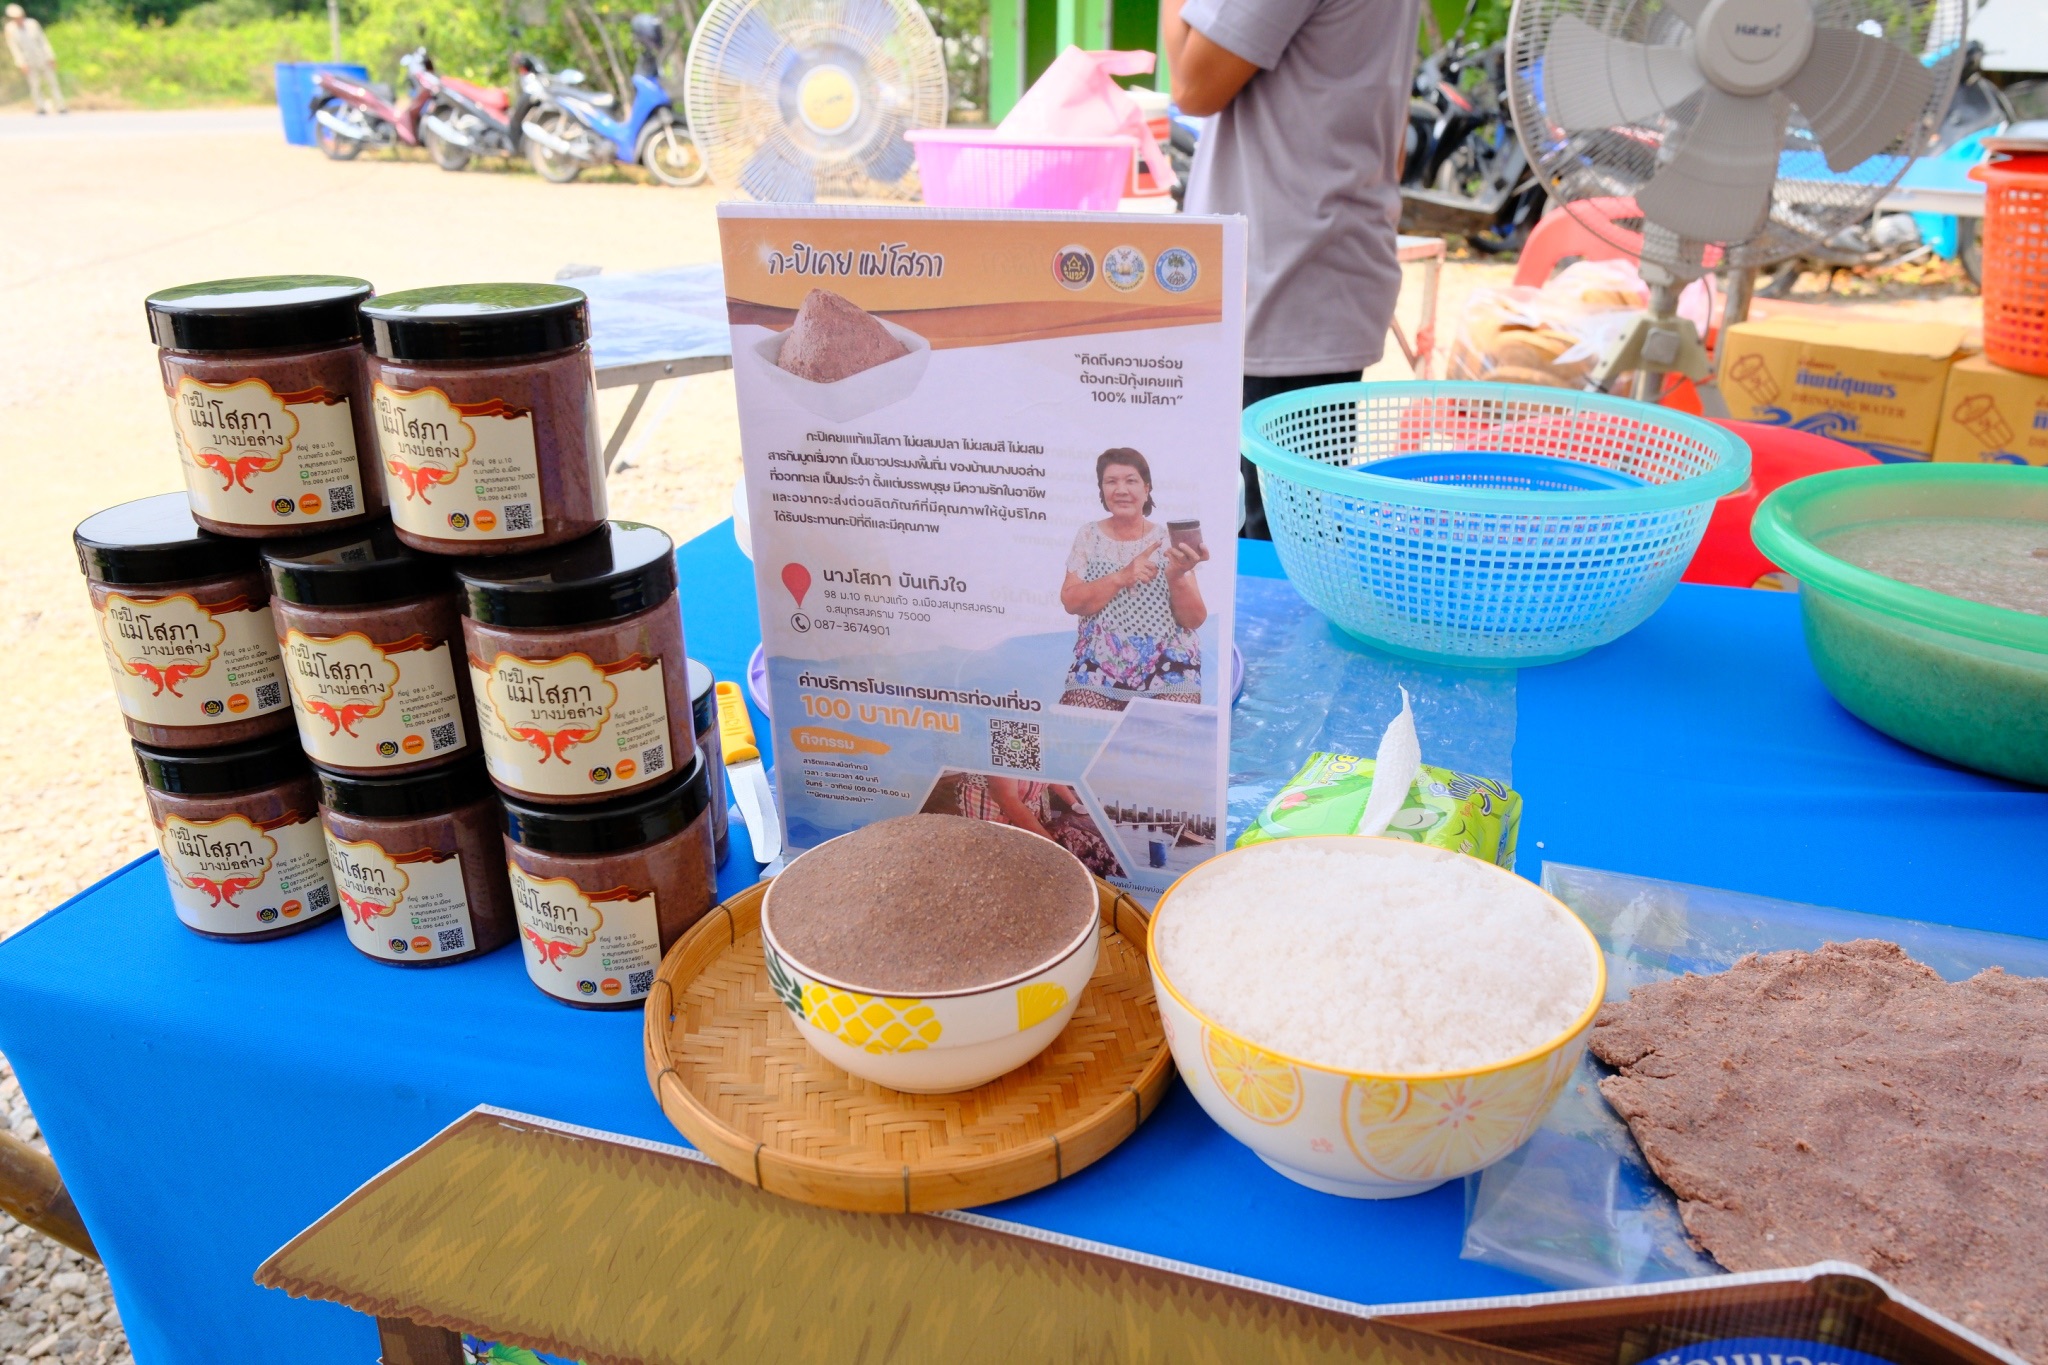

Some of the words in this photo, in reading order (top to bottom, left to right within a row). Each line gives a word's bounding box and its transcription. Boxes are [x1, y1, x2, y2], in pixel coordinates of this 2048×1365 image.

[769, 242, 852, 275] กะปิเคย
[859, 244, 943, 277] แม่โสภา
[1080, 370, 1183, 389] ต้องกะปิกุ้งเคยแท้
[182, 391, 204, 408] กะปิ
[377, 396, 391, 414] กะปิ
[1091, 391, 1126, 403] 100%
[190, 400, 271, 430] แม่โสภา
[382, 407, 448, 440] แม่โสภา
[213, 430, 284, 446] บางบ่อล่าง
[903, 435, 959, 450] ไม่ผสมปลา
[962, 438, 1005, 453] ไม่ผสมสี
[1008, 441, 1044, 455] ไม่ผสม
[398, 440, 459, 458] บางบ่อล่าง
[340, 455, 356, 463] 75000
[517, 473, 536, 481] 75000
[770, 467, 820, 483] ที่ออกทะเล
[823, 471, 870, 487] เป็นประจำ
[823, 568, 891, 587] นางโสภา
[899, 571, 967, 593] บันเทิงใจ
[824, 589, 837, 599] 98
[840, 591, 861, 602] ม.10
[864, 594, 908, 606] ต.บางแก้ว
[912, 598, 1005, 614] อ.เมืองสมุทรสงคราม
[111, 606, 132, 622] กะปิ
[825, 605, 894, 619] จ.สมุทรสงคราม
[898, 611, 931, 622] 75000
[118, 614, 199, 640] แม่โสภา
[814, 618, 890, 636] 087-3674901
[142, 640, 211, 656] บางบ่อล่าง
[290, 643, 309, 659] กะปิ
[265, 654, 280, 663] 75000
[298, 652, 373, 680] แม่โสภา
[499, 668, 524, 684] กะปิ
[319, 680, 385, 695] บางบ่อล่าง
[507, 676, 591, 704] แม่โสภา
[799, 672, 1041, 712] ค่าบริการโปรแกรมการท่องเที่ยว
[440, 694, 456, 703] 75000
[531, 702, 602, 720] บางบ่อล่าง
[802, 695, 850, 720] 100
[859, 705, 959, 732] บาท/คน
[800, 732, 855, 750] กิจกรรม
[169, 827, 190, 840] กะปิ
[177, 834, 252, 858] แม่โสภา
[200, 855, 265, 870] บางบ่อล่าง
[344, 881, 396, 896] บางบ่อล่าง
[449, 902, 466, 910] 75000
[517, 888, 578, 922] แม่โสภา
[532, 916, 588, 936] บางบ่อล่าง
[641, 943, 658, 951] 75000
